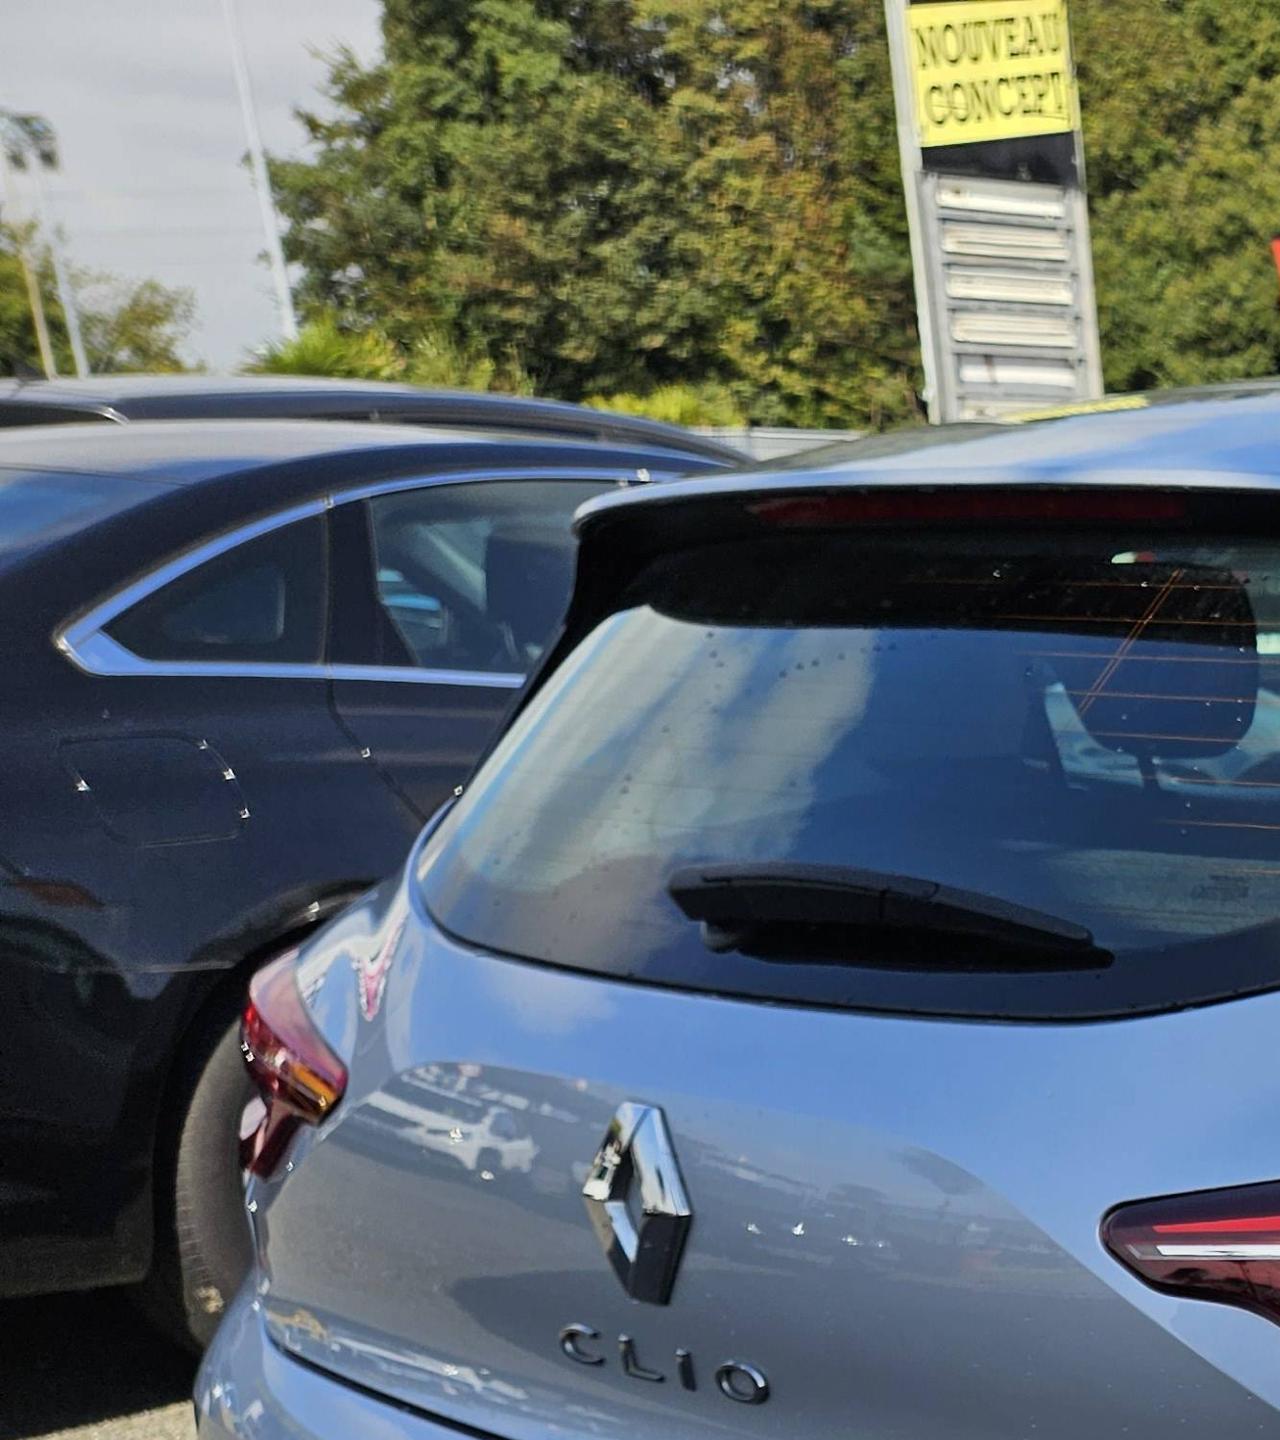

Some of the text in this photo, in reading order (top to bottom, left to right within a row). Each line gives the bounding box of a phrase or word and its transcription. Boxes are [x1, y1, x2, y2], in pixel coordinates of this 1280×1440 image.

[912, 14, 1061, 68] NOUVEAU
[926, 72, 1064, 124] CONCEPT
[560, 1323, 770, 1405] CLIO
